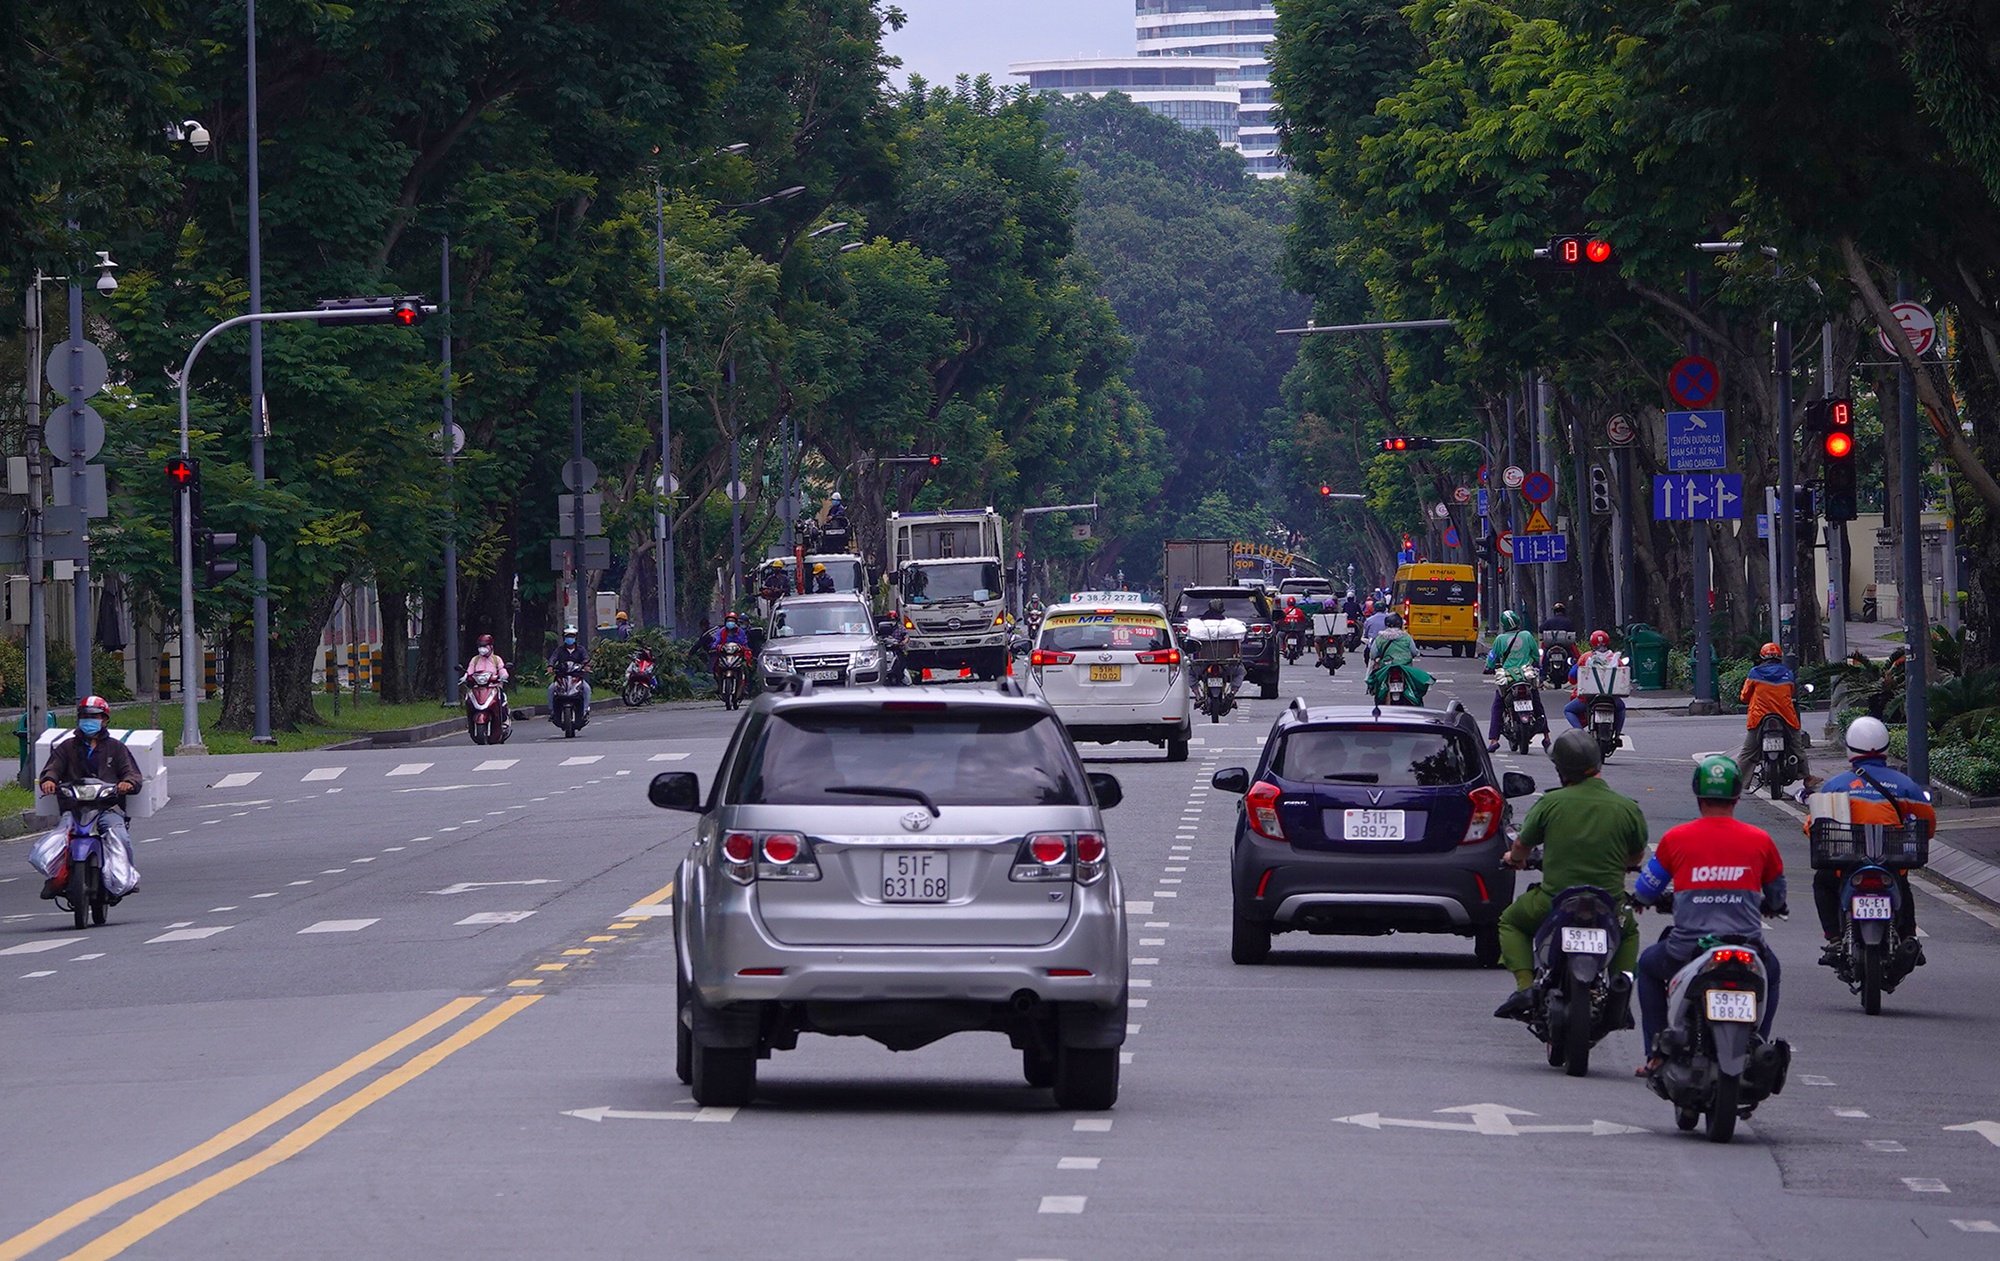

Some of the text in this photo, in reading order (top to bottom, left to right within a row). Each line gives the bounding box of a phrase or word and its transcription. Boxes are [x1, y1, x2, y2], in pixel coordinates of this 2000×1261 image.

[1565, 241, 1577, 261] 13
[1835, 404, 1848, 425] 13
[1694, 459, 1717, 468] CAMERA
[1078, 615, 1115, 624] MPE
[1362, 811, 1388, 824] 51H
[1351, 825, 1398, 838] 389.72
[898, 855, 932, 876] 51F
[1691, 866, 1745, 883] LOSHIP
[884, 877, 946, 898] 631.68
[1692, 895, 1713, 904] GIAO
[1715, 993, 1748, 1007] 59-F2
